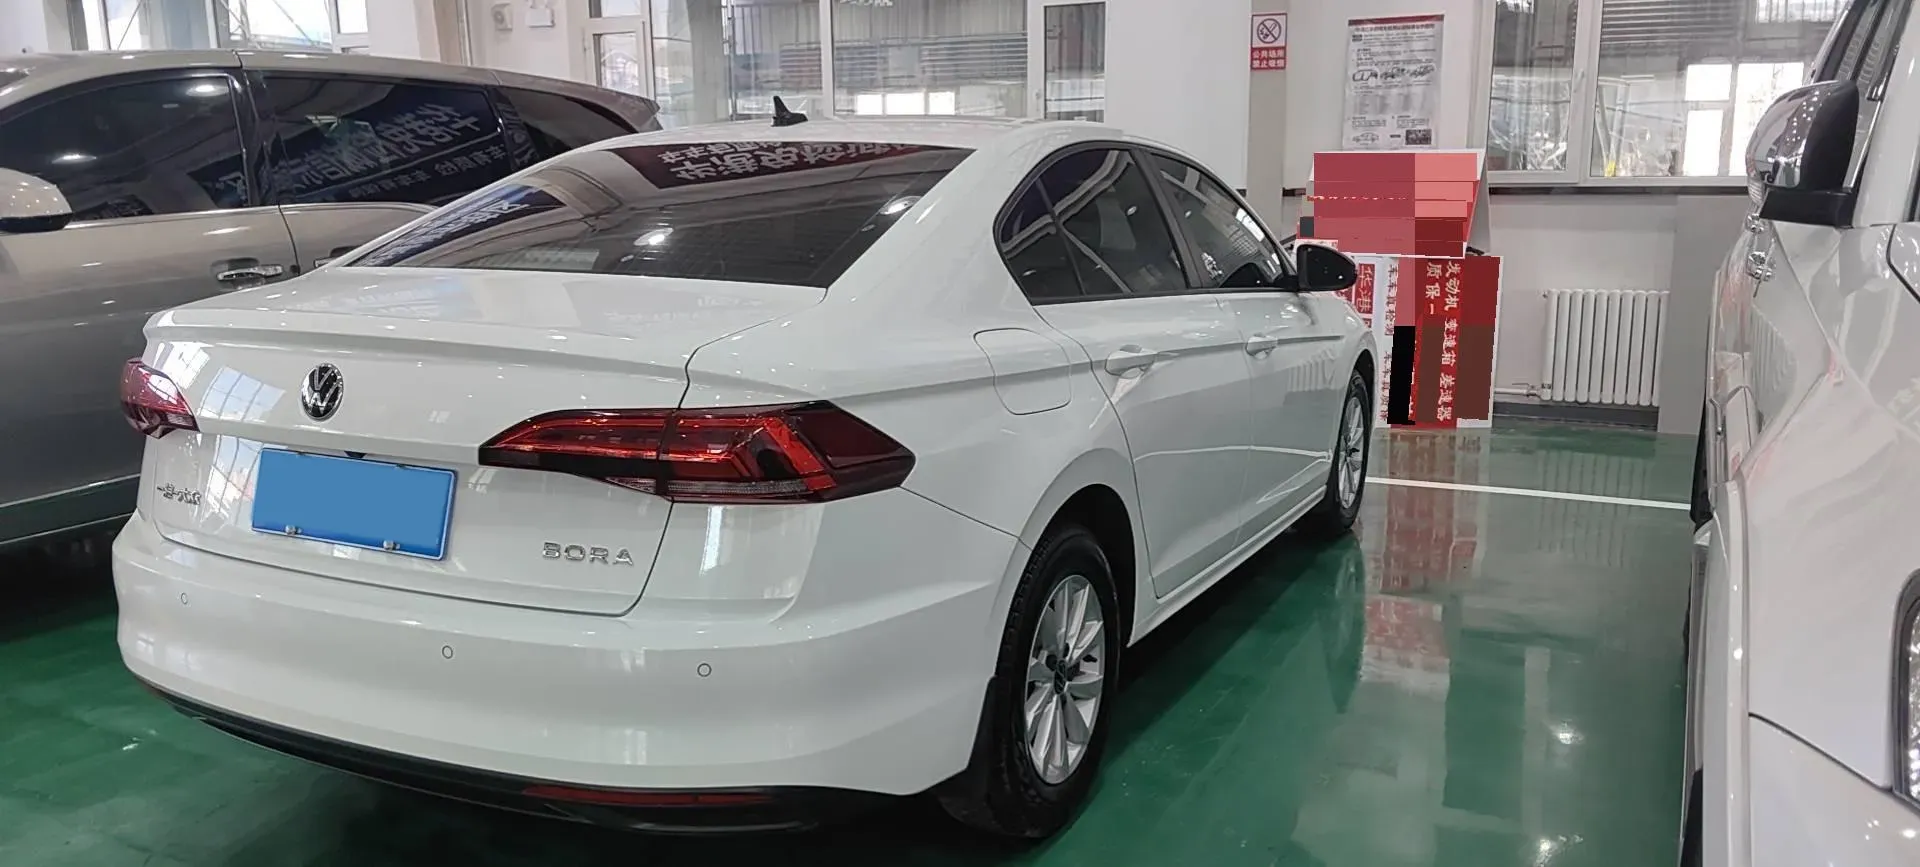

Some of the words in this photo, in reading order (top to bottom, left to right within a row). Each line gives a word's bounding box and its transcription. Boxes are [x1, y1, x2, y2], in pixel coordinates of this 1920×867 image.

[1252, 59, 1284, 68] 禁止吸烟
[1357, 264, 1373, 312] 华港
[1444, 260, 1461, 311] 发动机
[1441, 317, 1458, 367] 变速箱
[1437, 372, 1455, 421] 差速器
[542, 541, 634, 566] BORA
